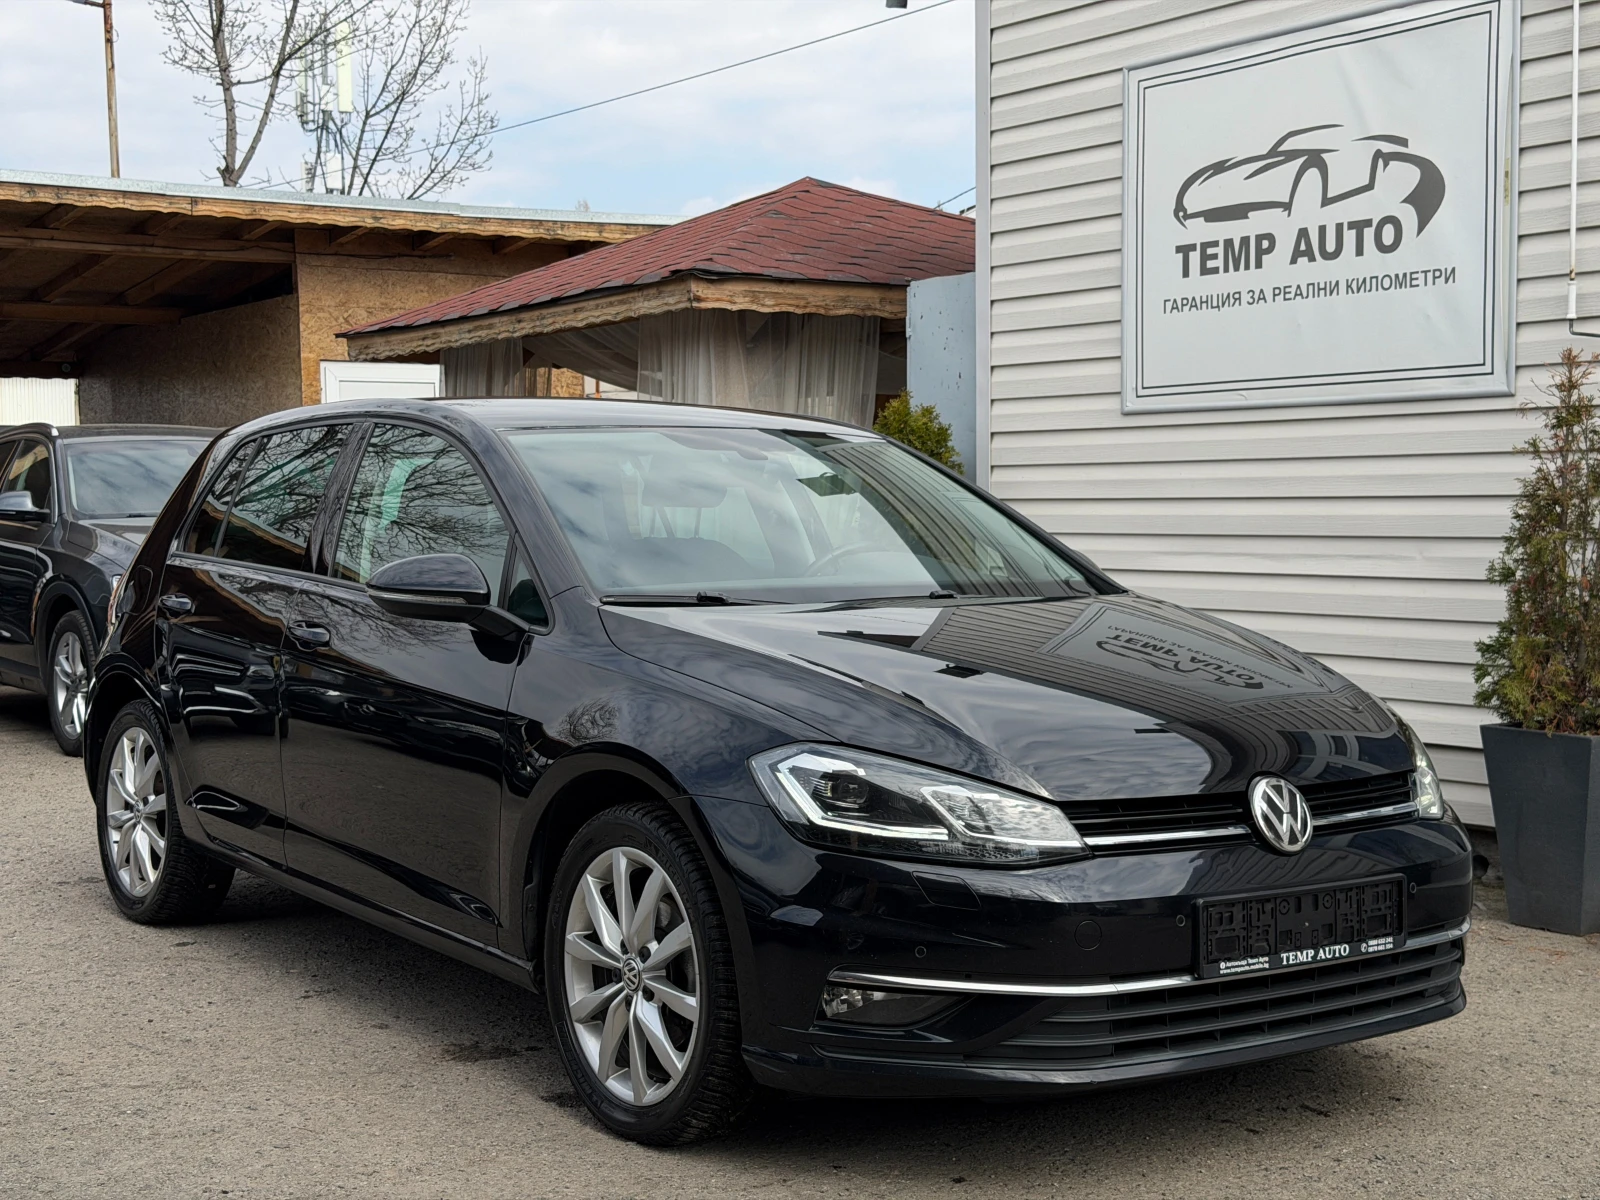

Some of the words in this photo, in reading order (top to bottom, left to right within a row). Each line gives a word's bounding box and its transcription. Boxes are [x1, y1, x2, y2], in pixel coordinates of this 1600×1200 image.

[1175, 232, 1277, 279] TEMP
[1289, 214, 1403, 266] AUTO
[1163, 291, 1242, 315] ГАРАНЦИЯ
[1246, 288, 1267, 306] ЗА
[1272, 280, 1340, 303] РЕАЛНИ
[1345, 266, 1456, 295] КИЛОМЕТРИ
[1253, 777, 1309, 850] VW
[1280, 948, 1315, 965] TEMP
[1316, 943, 1350, 960] AUTO
